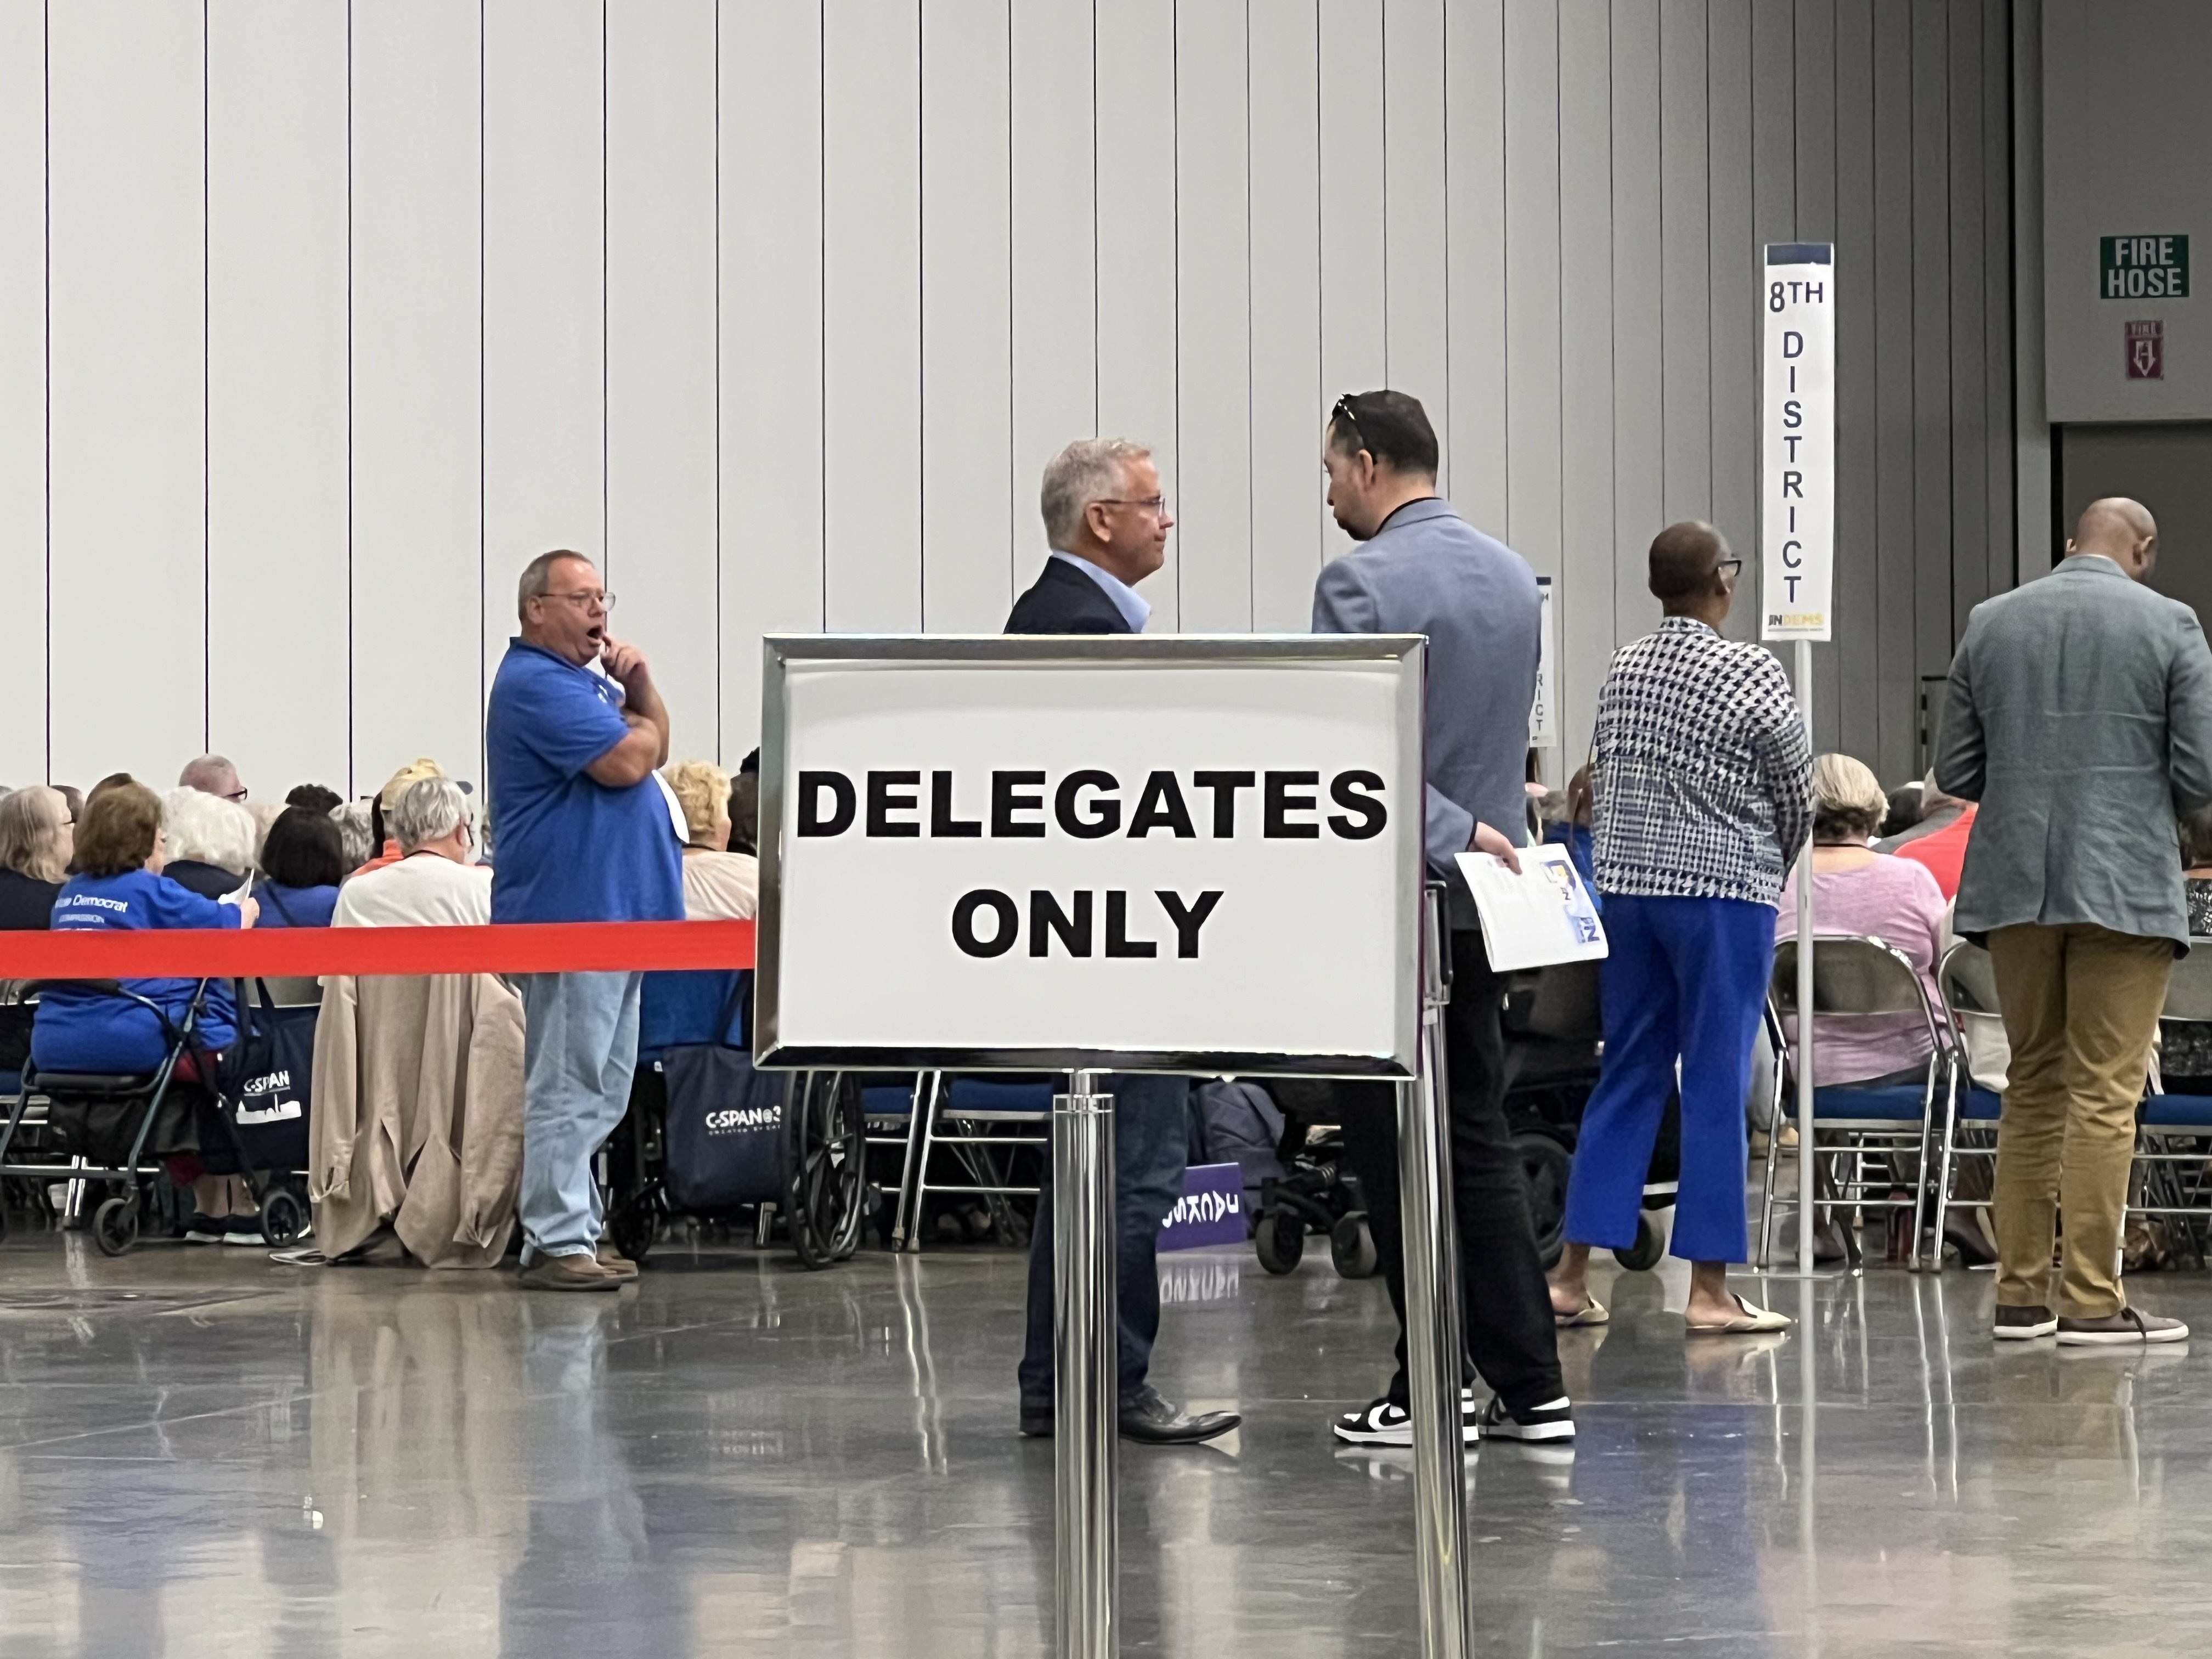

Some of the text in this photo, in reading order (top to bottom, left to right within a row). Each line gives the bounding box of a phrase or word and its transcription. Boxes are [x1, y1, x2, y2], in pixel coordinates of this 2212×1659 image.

[2115, 238, 2174, 266] FIRE
[1769, 281, 1823, 312] 8TH
[2108, 268, 2182, 297] HOSE
[1782, 331, 1804, 603] DISTRICT
[797, 769, 1387, 840] DELEGATES
[72, 894, 128, 913] Democrat
[951, 888, 1224, 959] ONLY
